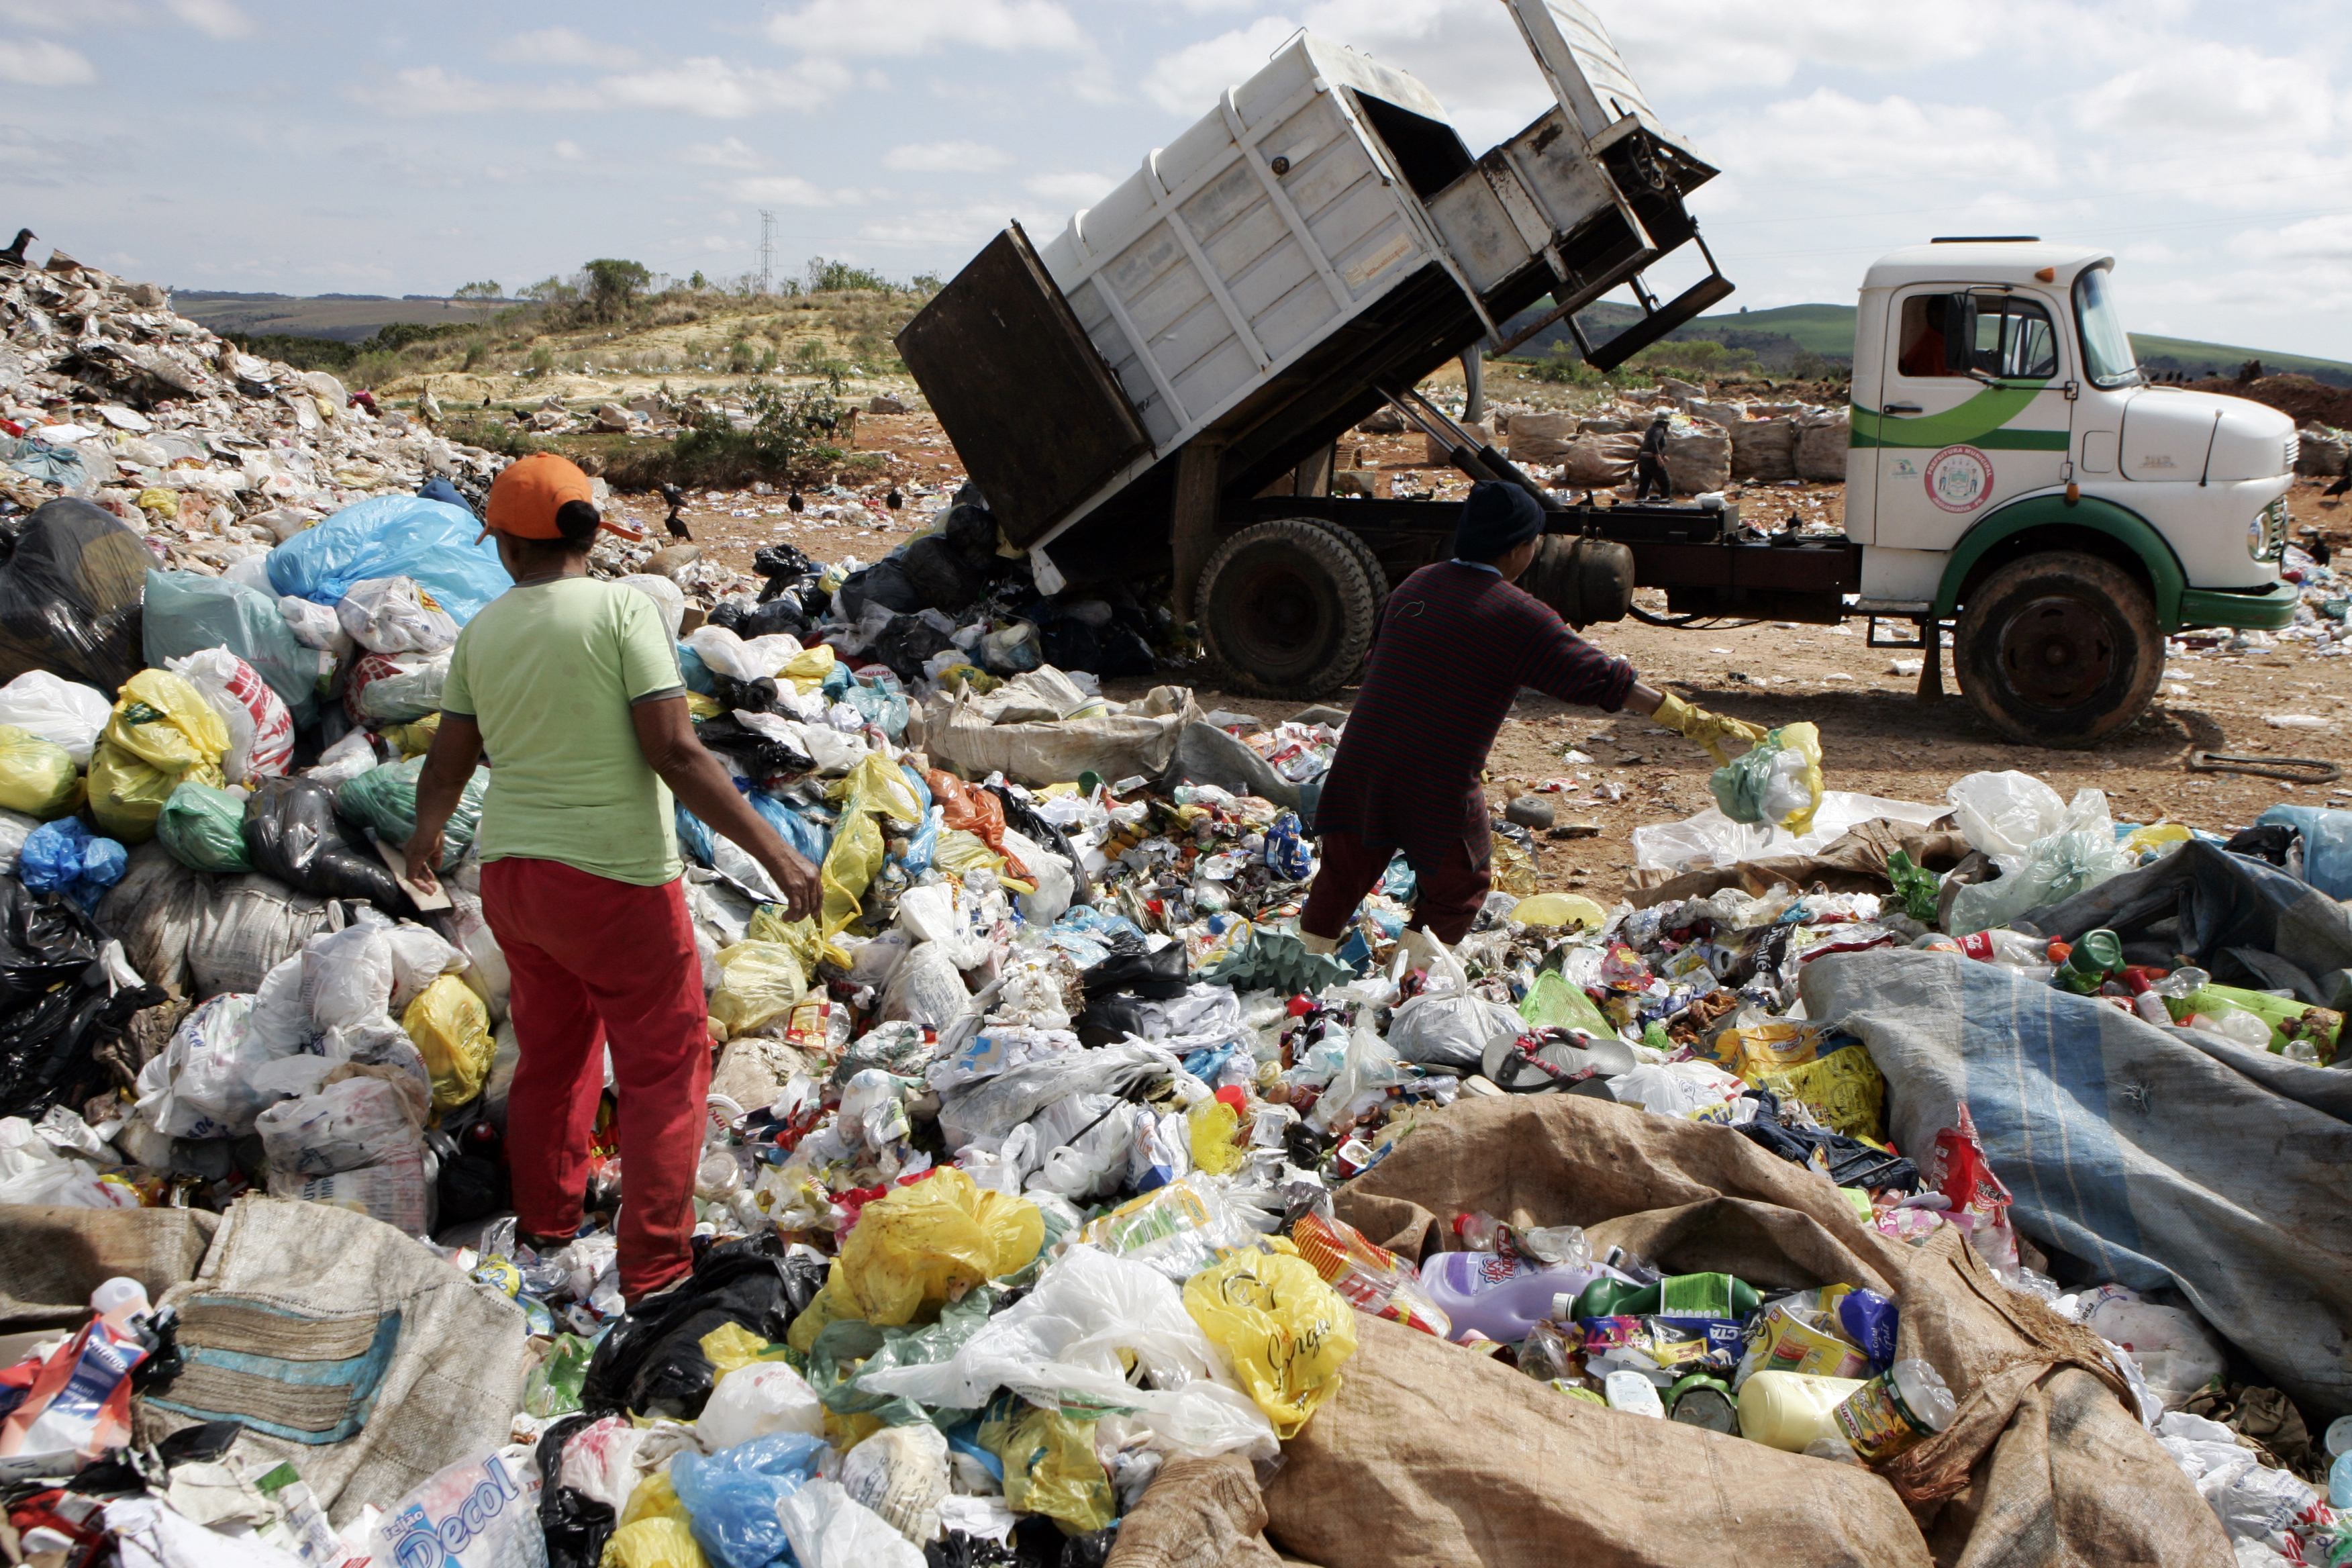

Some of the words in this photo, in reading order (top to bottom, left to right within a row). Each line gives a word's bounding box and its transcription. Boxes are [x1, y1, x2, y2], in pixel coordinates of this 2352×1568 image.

[1927, 448, 1963, 475] PREFEITURA
[1964, 448, 1992, 477] MUNICIPAL
[1485, 1259, 1505, 1282] Soft
[1870, 1327, 1879, 1348] Cristal
[393, 1453, 520, 1568] Decol
[381, 1510, 425, 1541] Feijão
